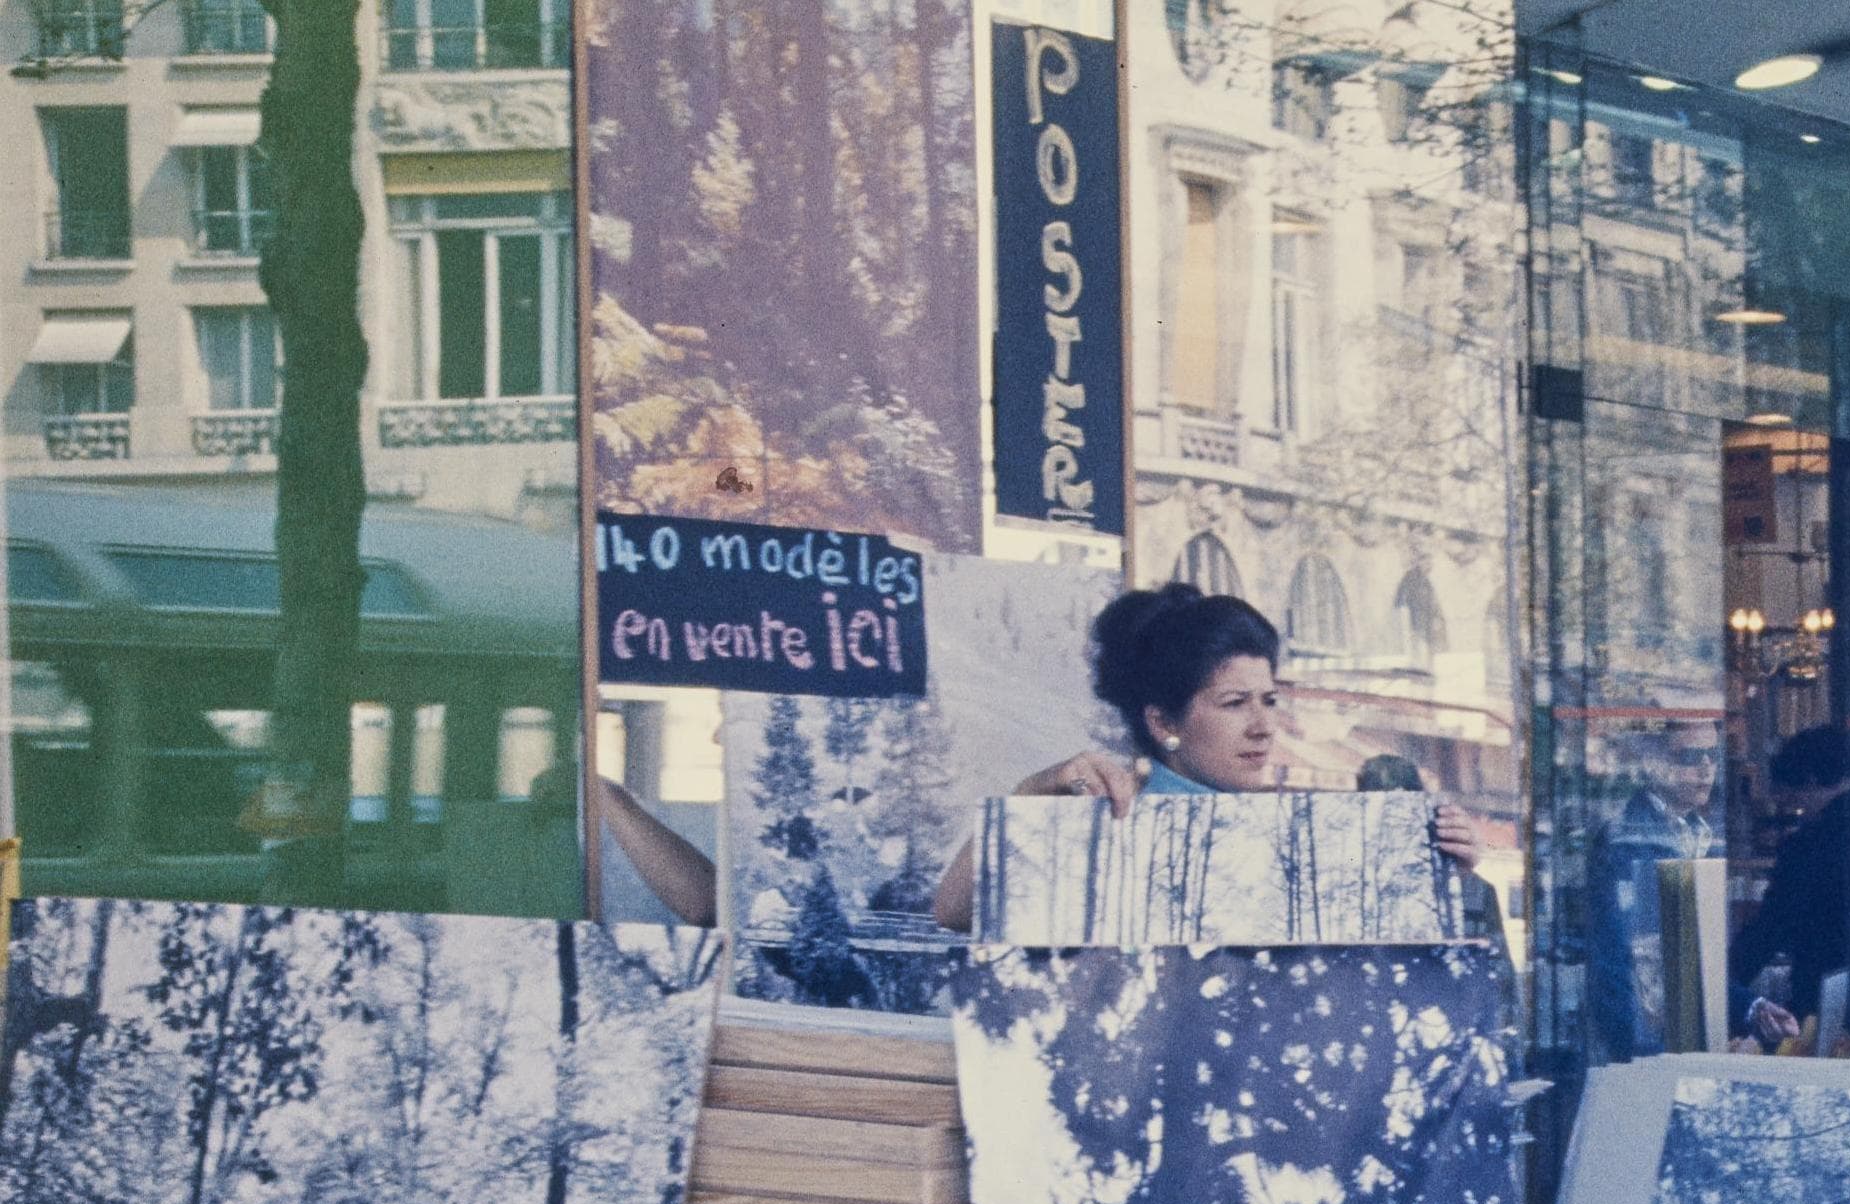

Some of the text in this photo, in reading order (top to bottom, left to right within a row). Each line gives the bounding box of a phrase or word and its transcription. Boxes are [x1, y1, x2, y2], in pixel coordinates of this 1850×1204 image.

[595, 523, 919, 604] 140 modèles
[612, 608, 671, 662] en
[683, 610, 815, 671] vente
